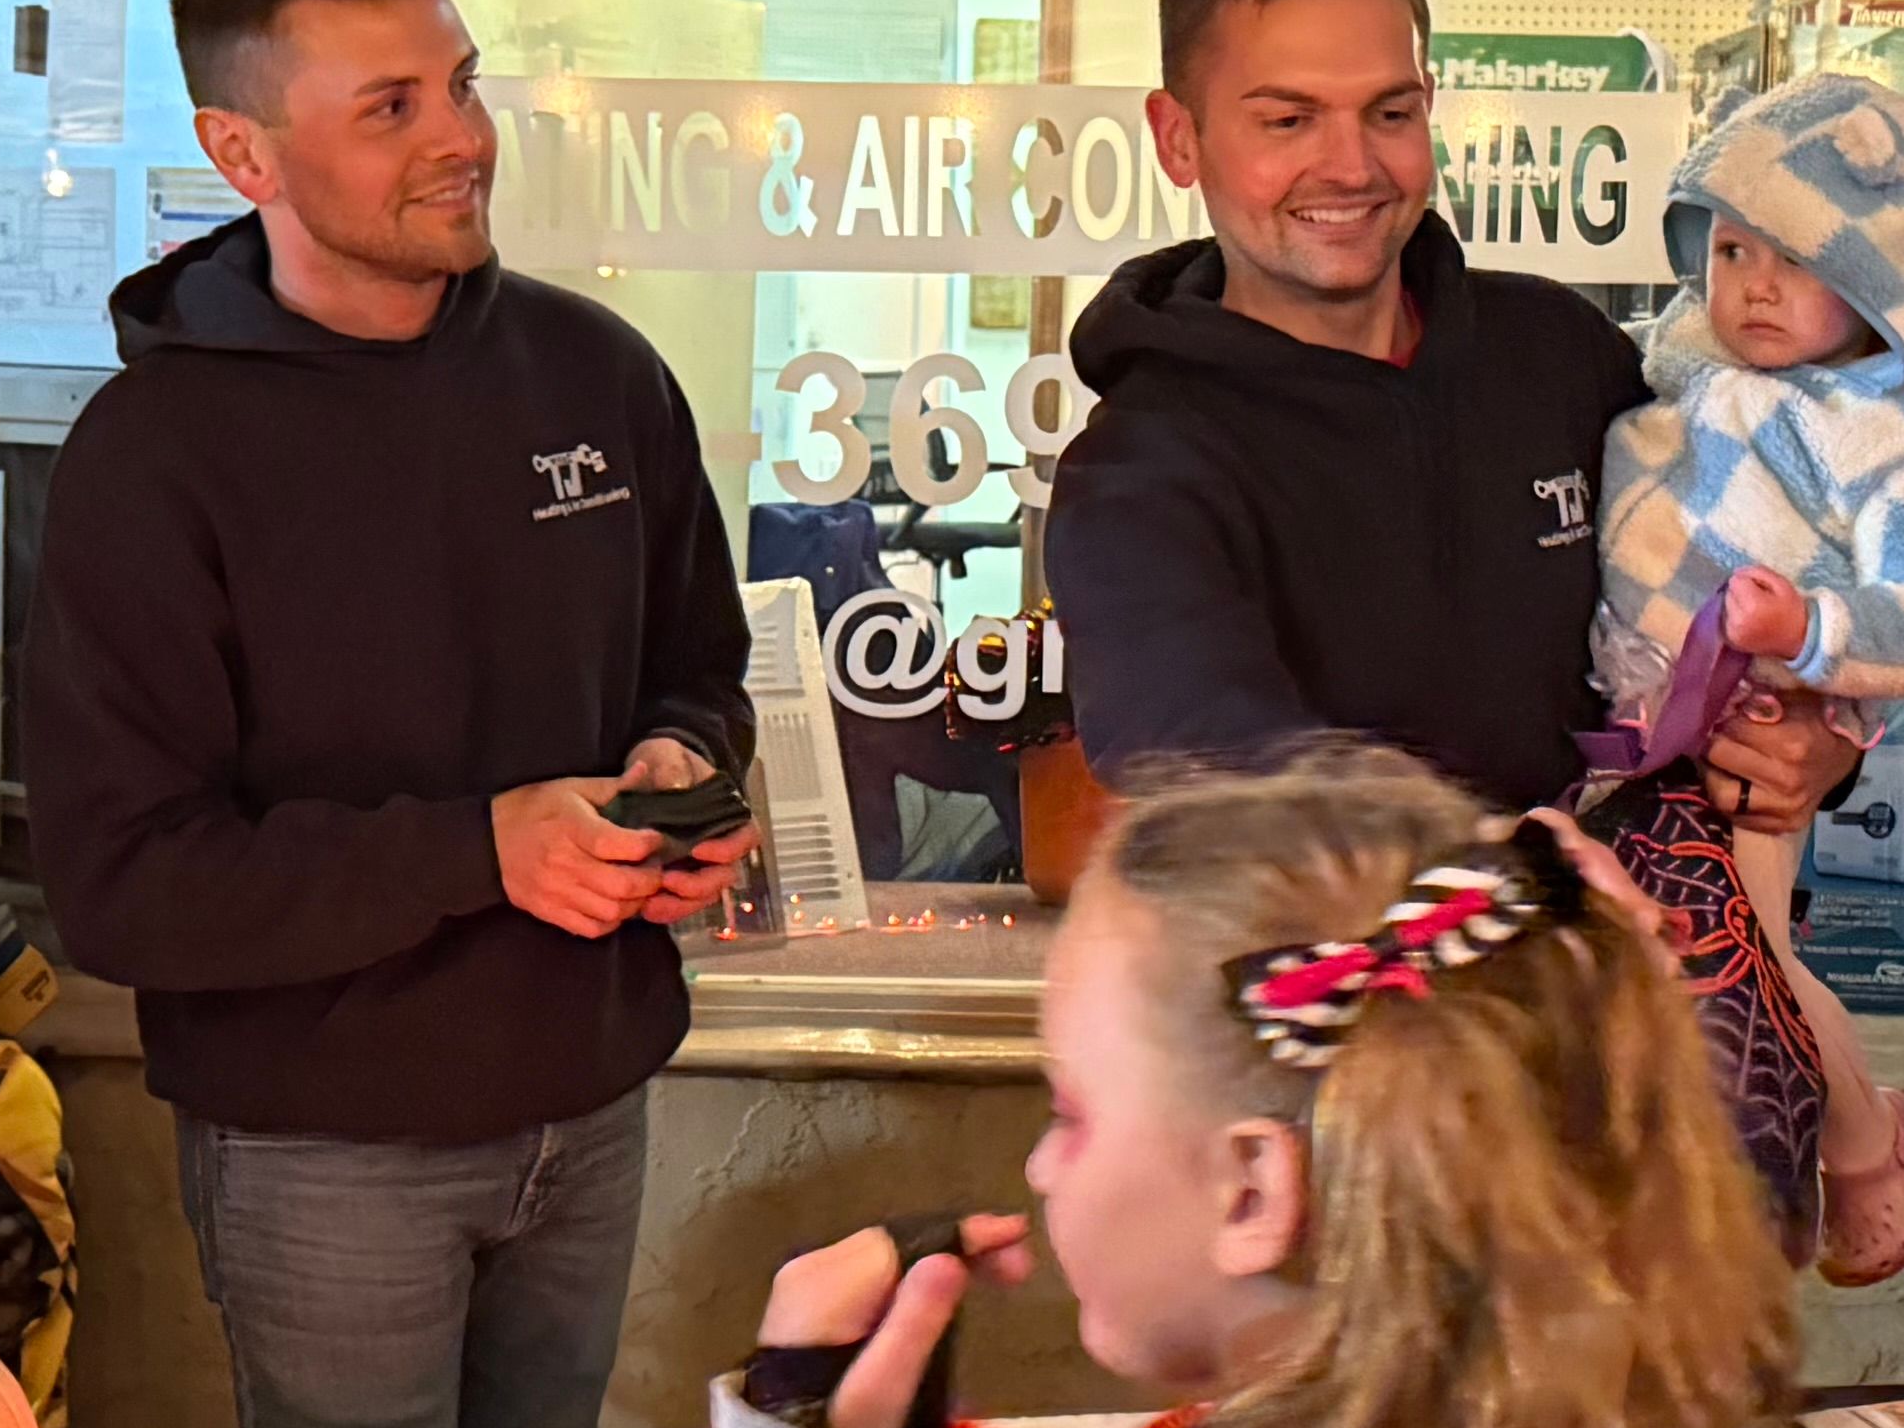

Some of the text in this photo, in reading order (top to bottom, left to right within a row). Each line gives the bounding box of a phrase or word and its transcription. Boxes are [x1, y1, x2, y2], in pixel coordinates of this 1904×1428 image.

[1443, 57, 1610, 92] Malarkey
[496, 109, 731, 235] ATING
[759, 113, 818, 239] &
[836, 115, 981, 238] AIR
